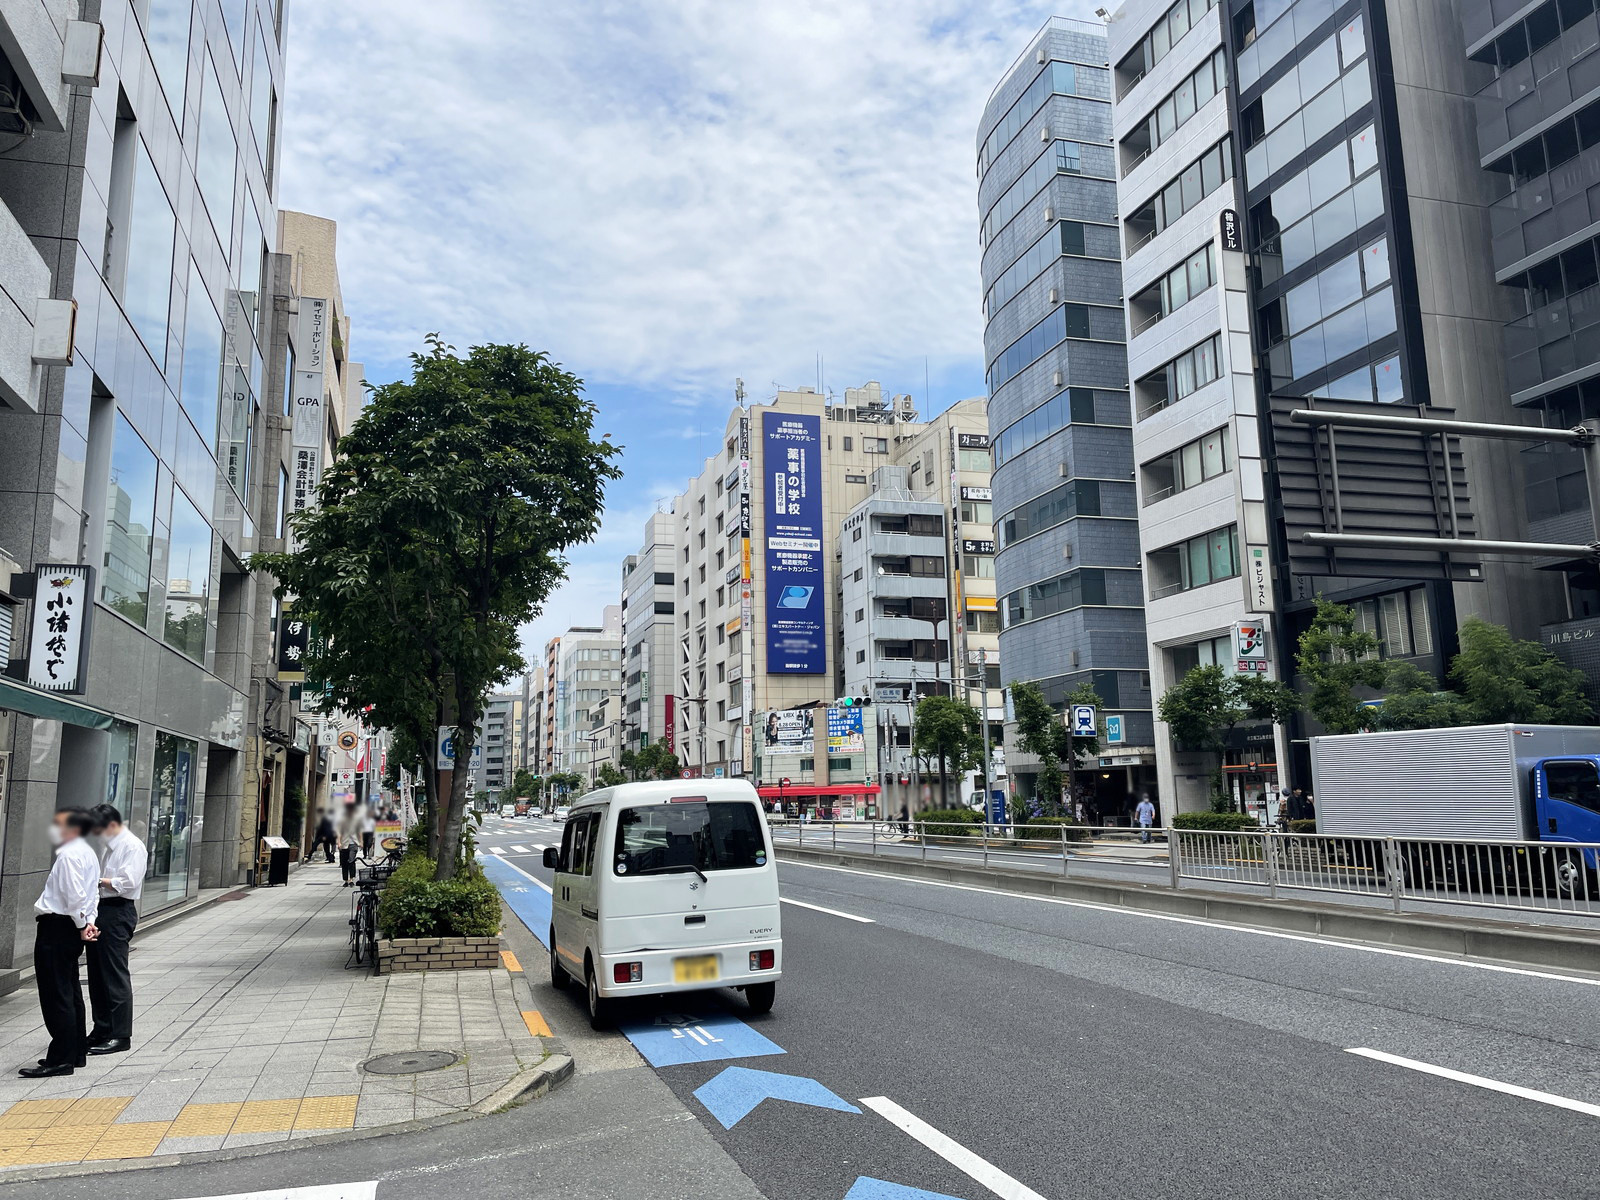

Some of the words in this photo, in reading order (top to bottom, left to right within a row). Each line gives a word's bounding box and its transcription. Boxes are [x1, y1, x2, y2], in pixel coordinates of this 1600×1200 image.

[297, 397, 320, 407] GPA
[769, 433, 816, 442] サポートアカデミー
[787, 447, 801, 515] 薬事の学校
[771, 565, 819, 573] サポートカンパニー
[285, 621, 303, 661] 伊勢
[1550, 629, 1595, 644] 川島ビル
